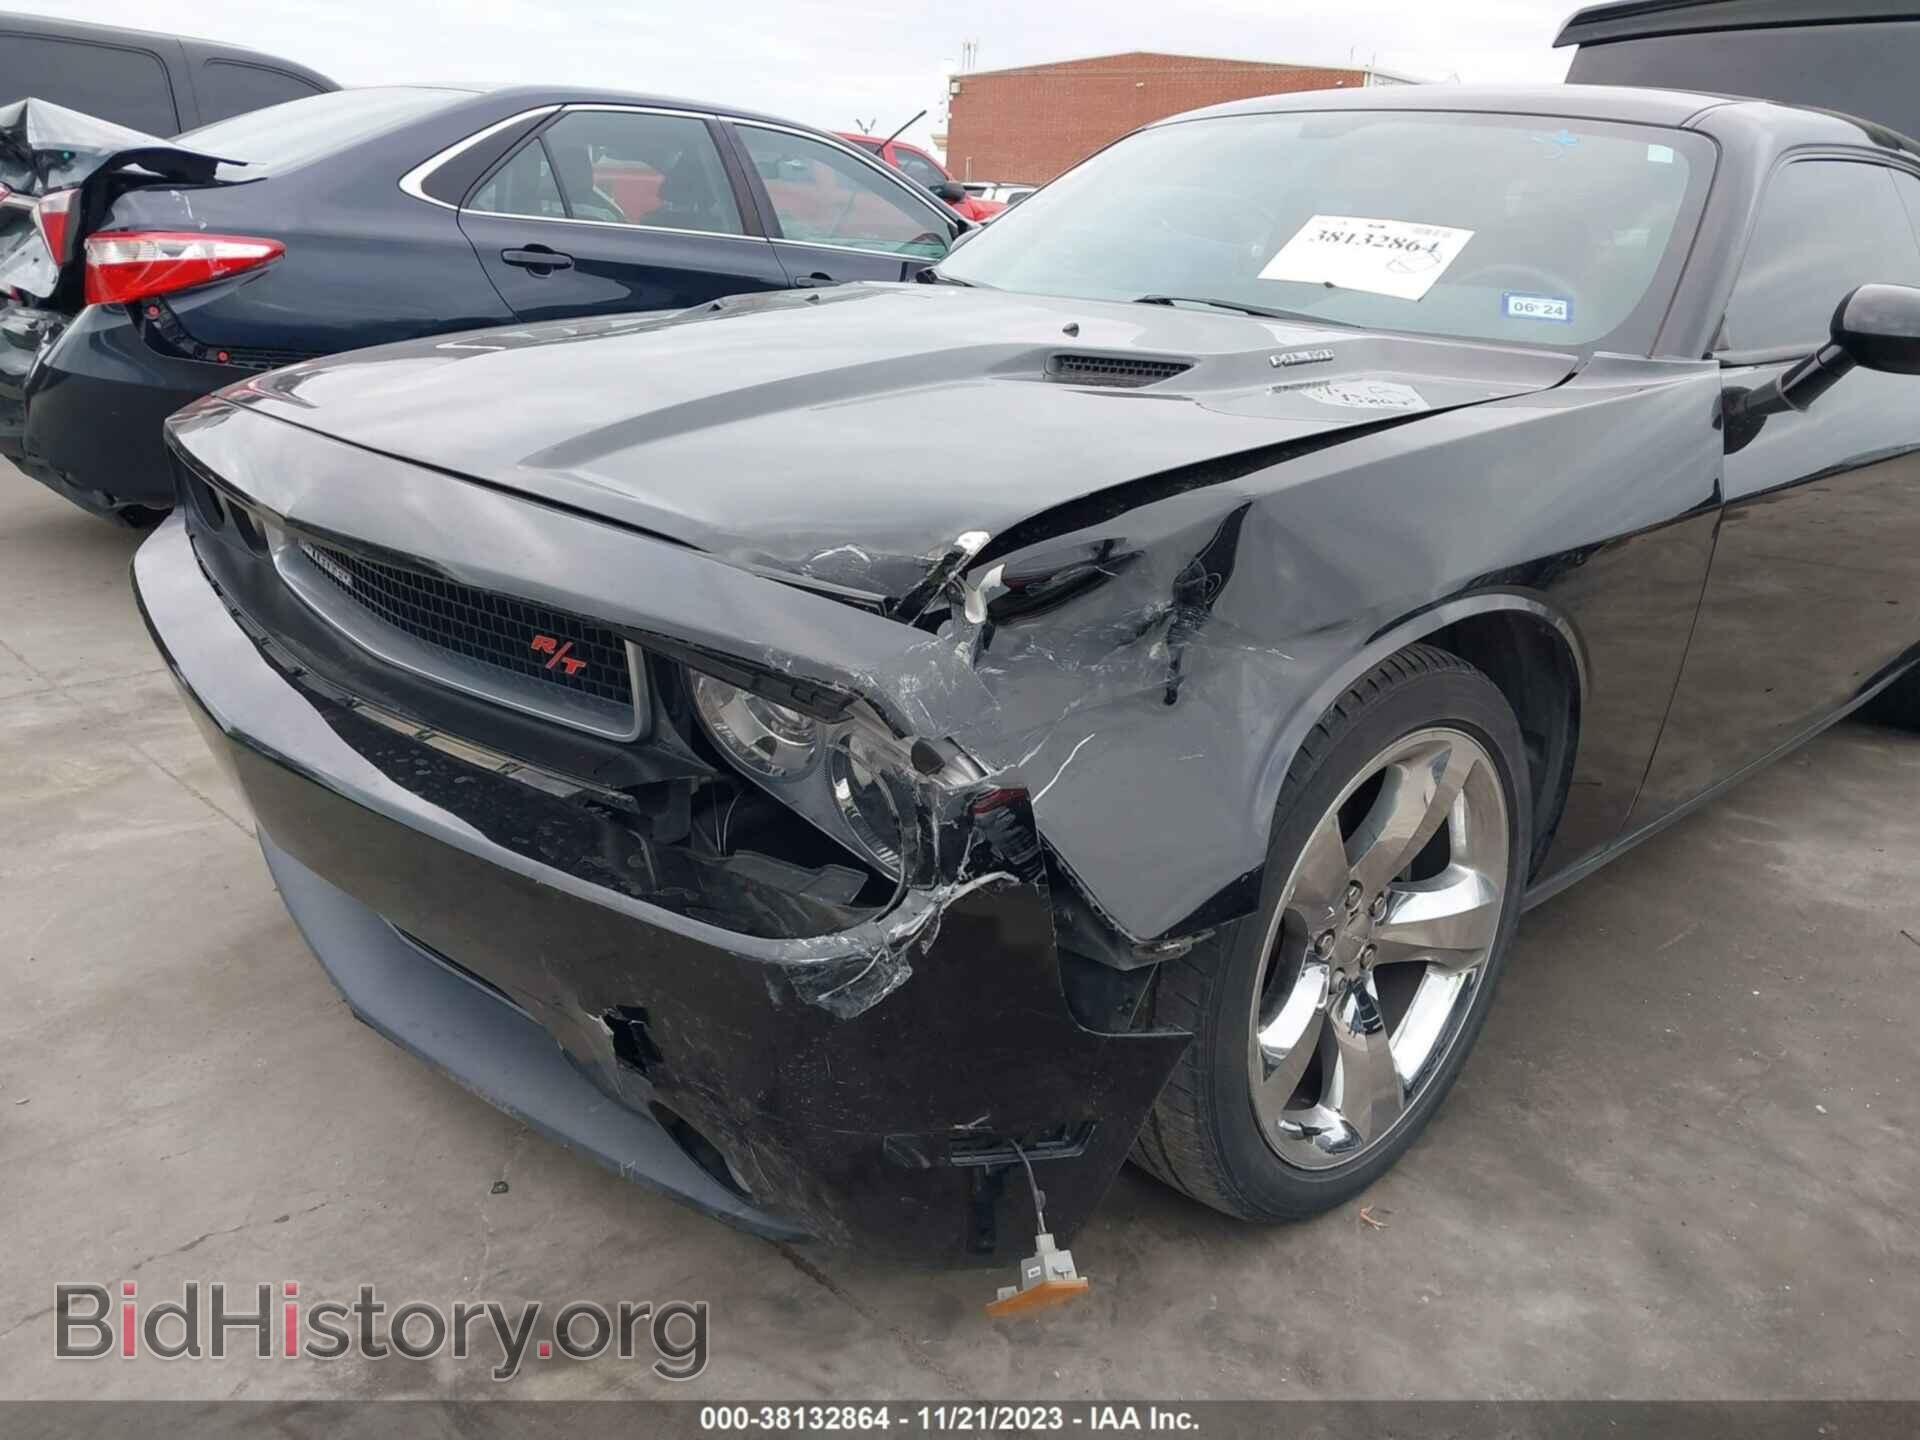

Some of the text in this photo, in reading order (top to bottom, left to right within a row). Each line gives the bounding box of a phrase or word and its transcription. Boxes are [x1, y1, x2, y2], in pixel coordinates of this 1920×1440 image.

[1308, 228, 1441, 254] 38132864
[1542, 303, 1564, 316] 24
[530, 633, 587, 676] R/T
